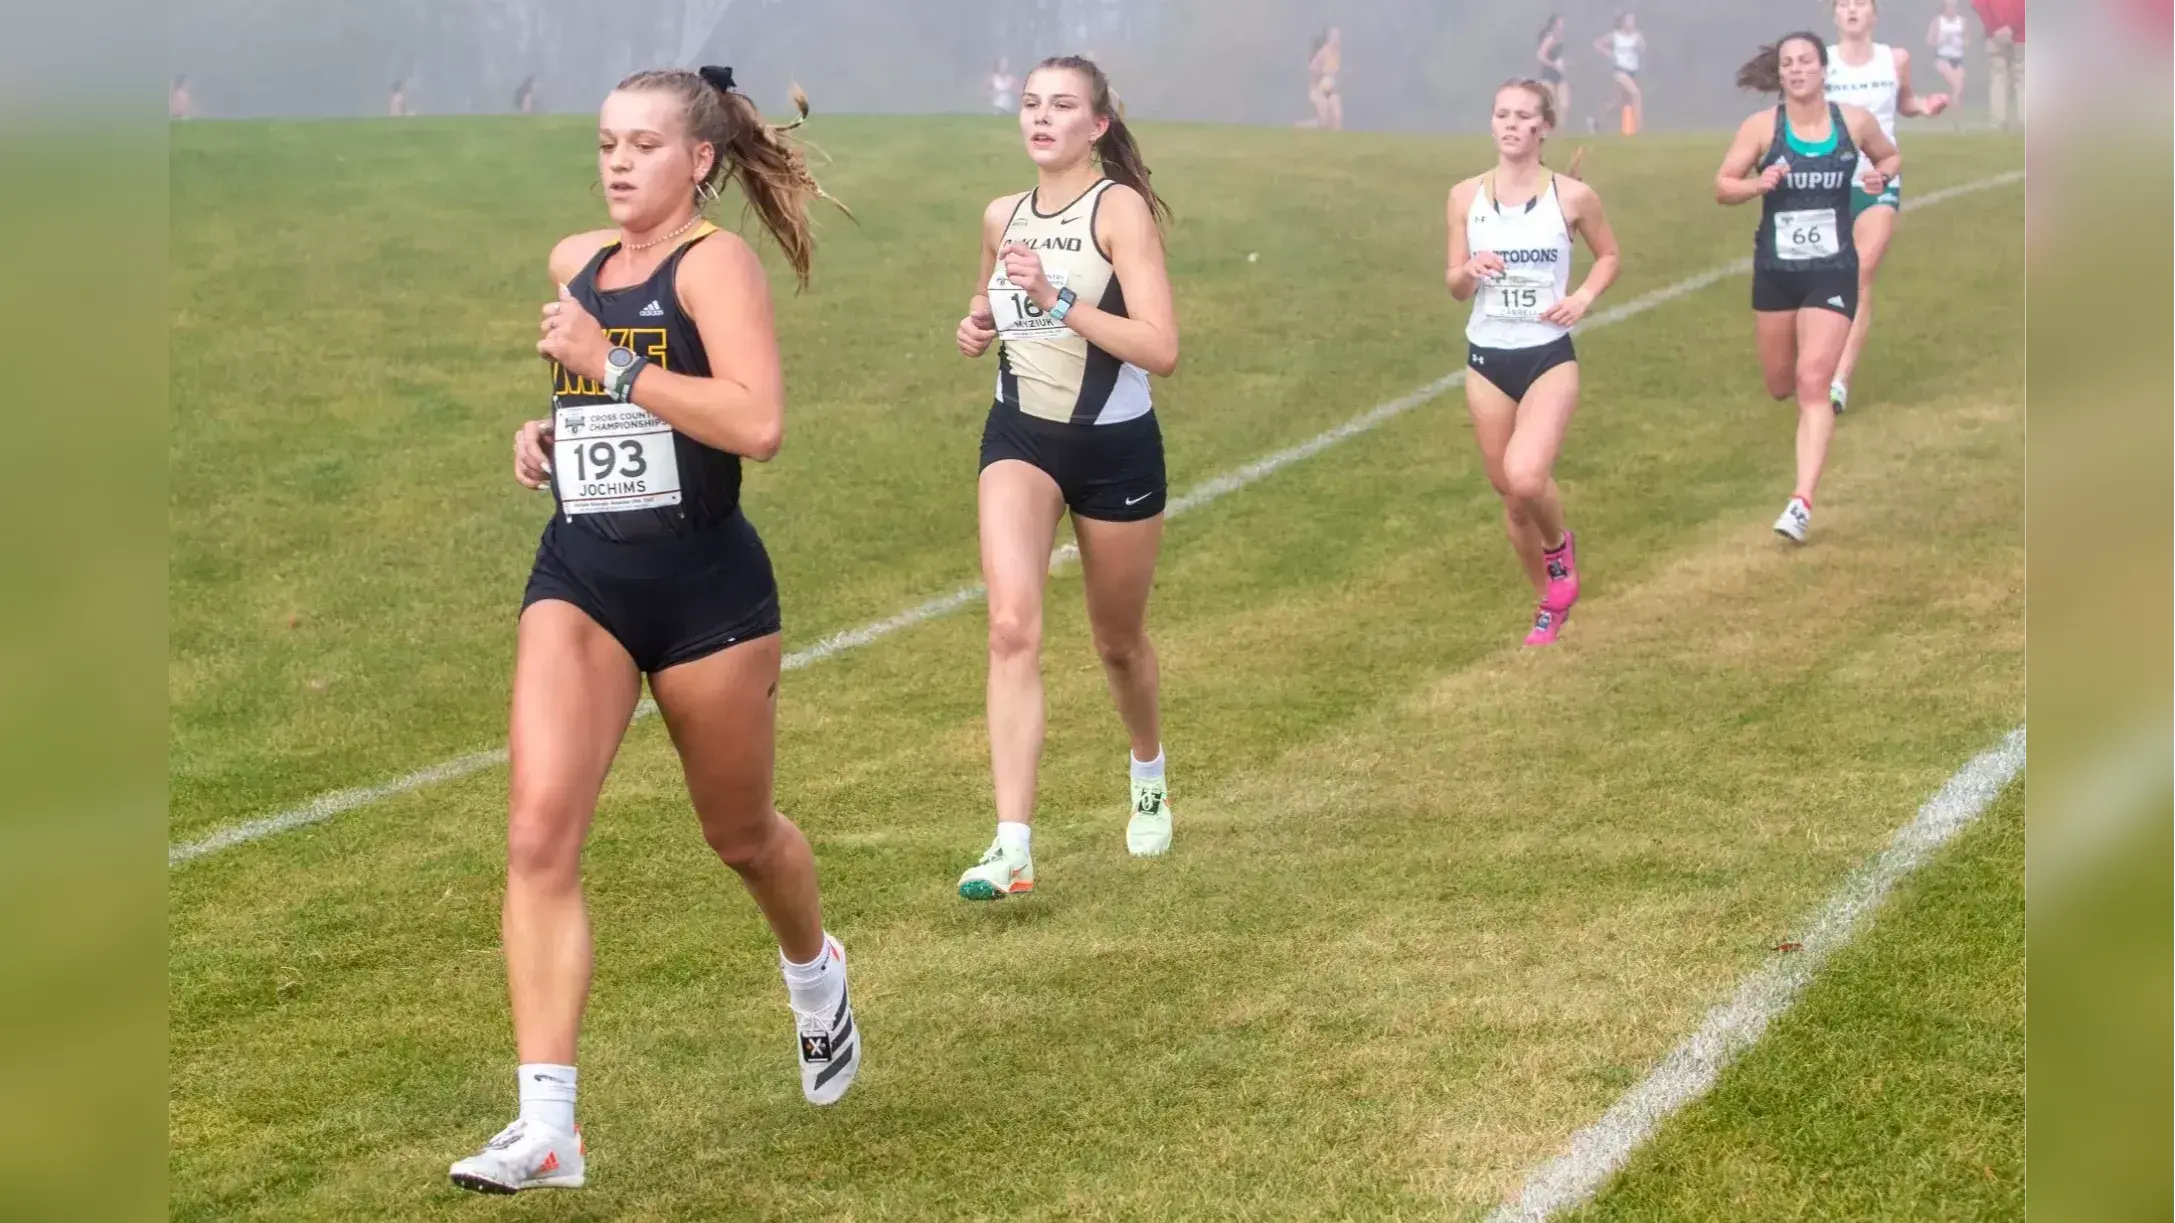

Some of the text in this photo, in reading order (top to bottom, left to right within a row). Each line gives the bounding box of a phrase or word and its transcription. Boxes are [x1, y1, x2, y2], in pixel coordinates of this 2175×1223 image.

[1786, 171, 1845, 189] IUPUI
[1792, 224, 1821, 245] 66
[1004, 237, 1083, 252] KLAND
[1473, 248, 1559, 264] TODONS
[1501, 289, 1537, 308] 115
[639, 309, 665, 317] adidas
[590, 410, 661, 422] CROSS COUNT
[589, 418, 668, 431] CHAMPIONSHIPS
[573, 440, 647, 481] 193
[579, 480, 647, 497] JOCHIMS
